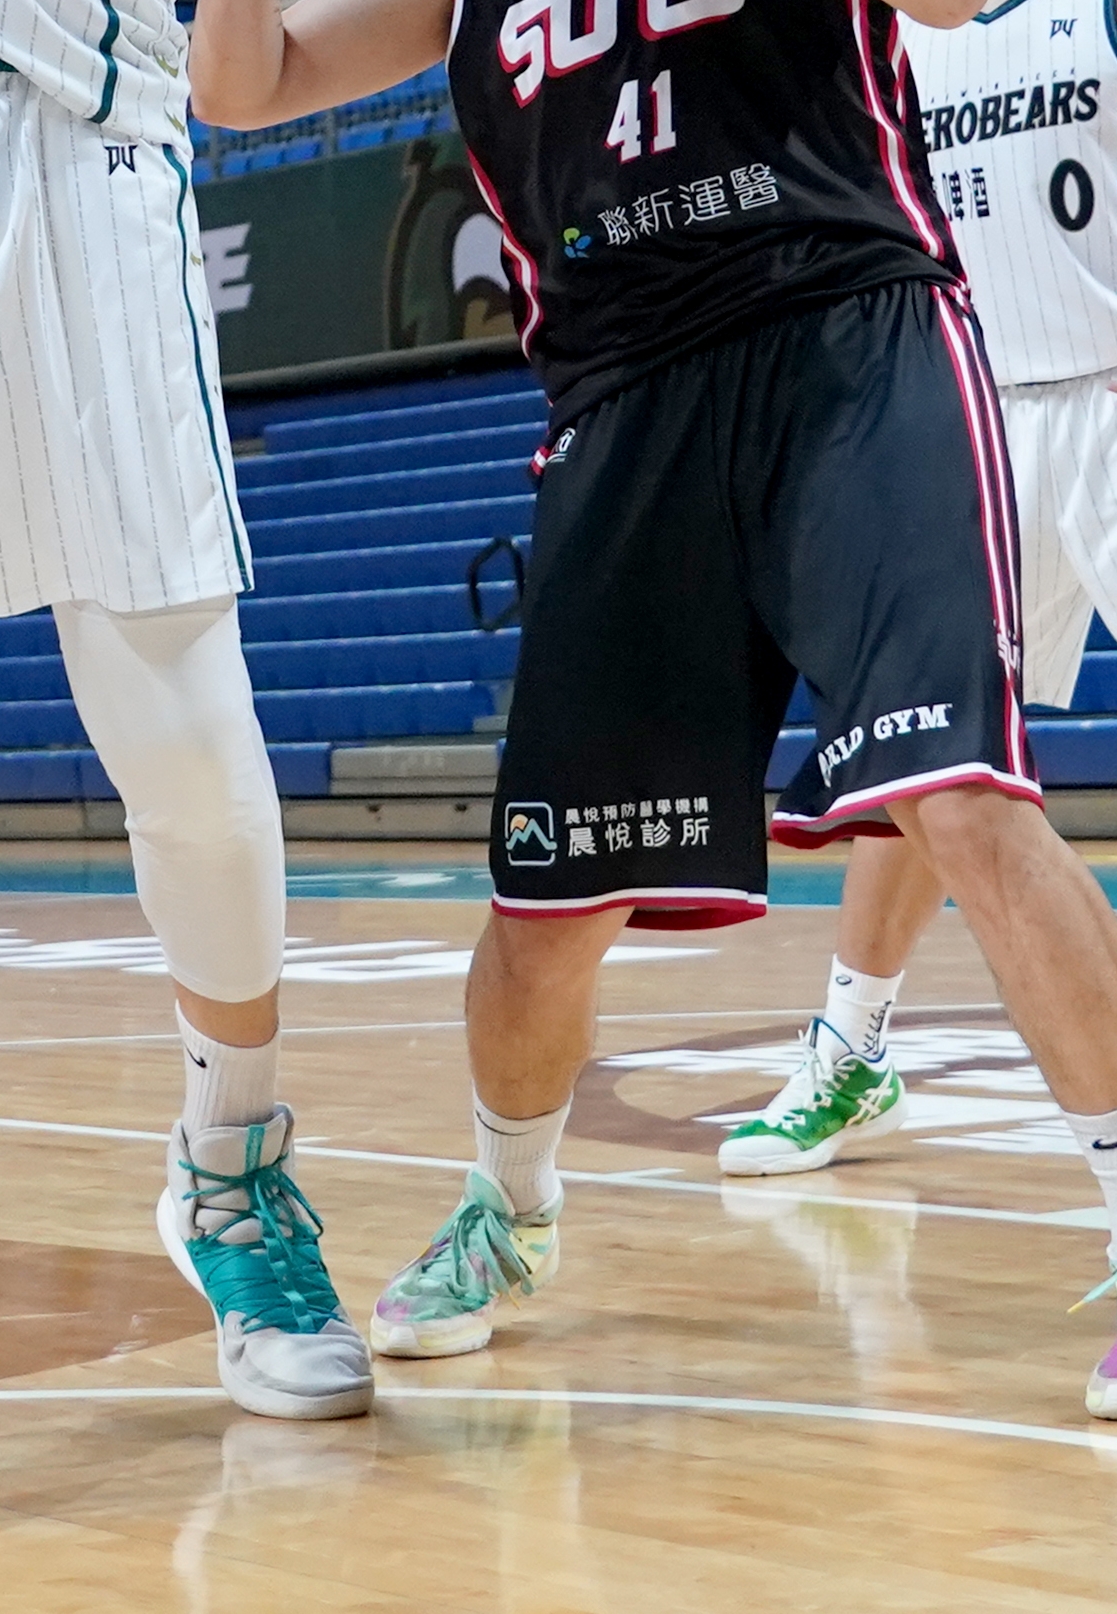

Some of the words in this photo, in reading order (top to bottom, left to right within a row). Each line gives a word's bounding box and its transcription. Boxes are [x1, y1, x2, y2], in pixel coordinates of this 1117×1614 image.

[604, 70, 677, 164] 41
[921, 78, 1101, 154] EROBEARS
[597, 162, 780, 247] 聯新運醫
[1049, 158, 1095, 233] 0
[568, 817, 710, 857] 晨悅診所
